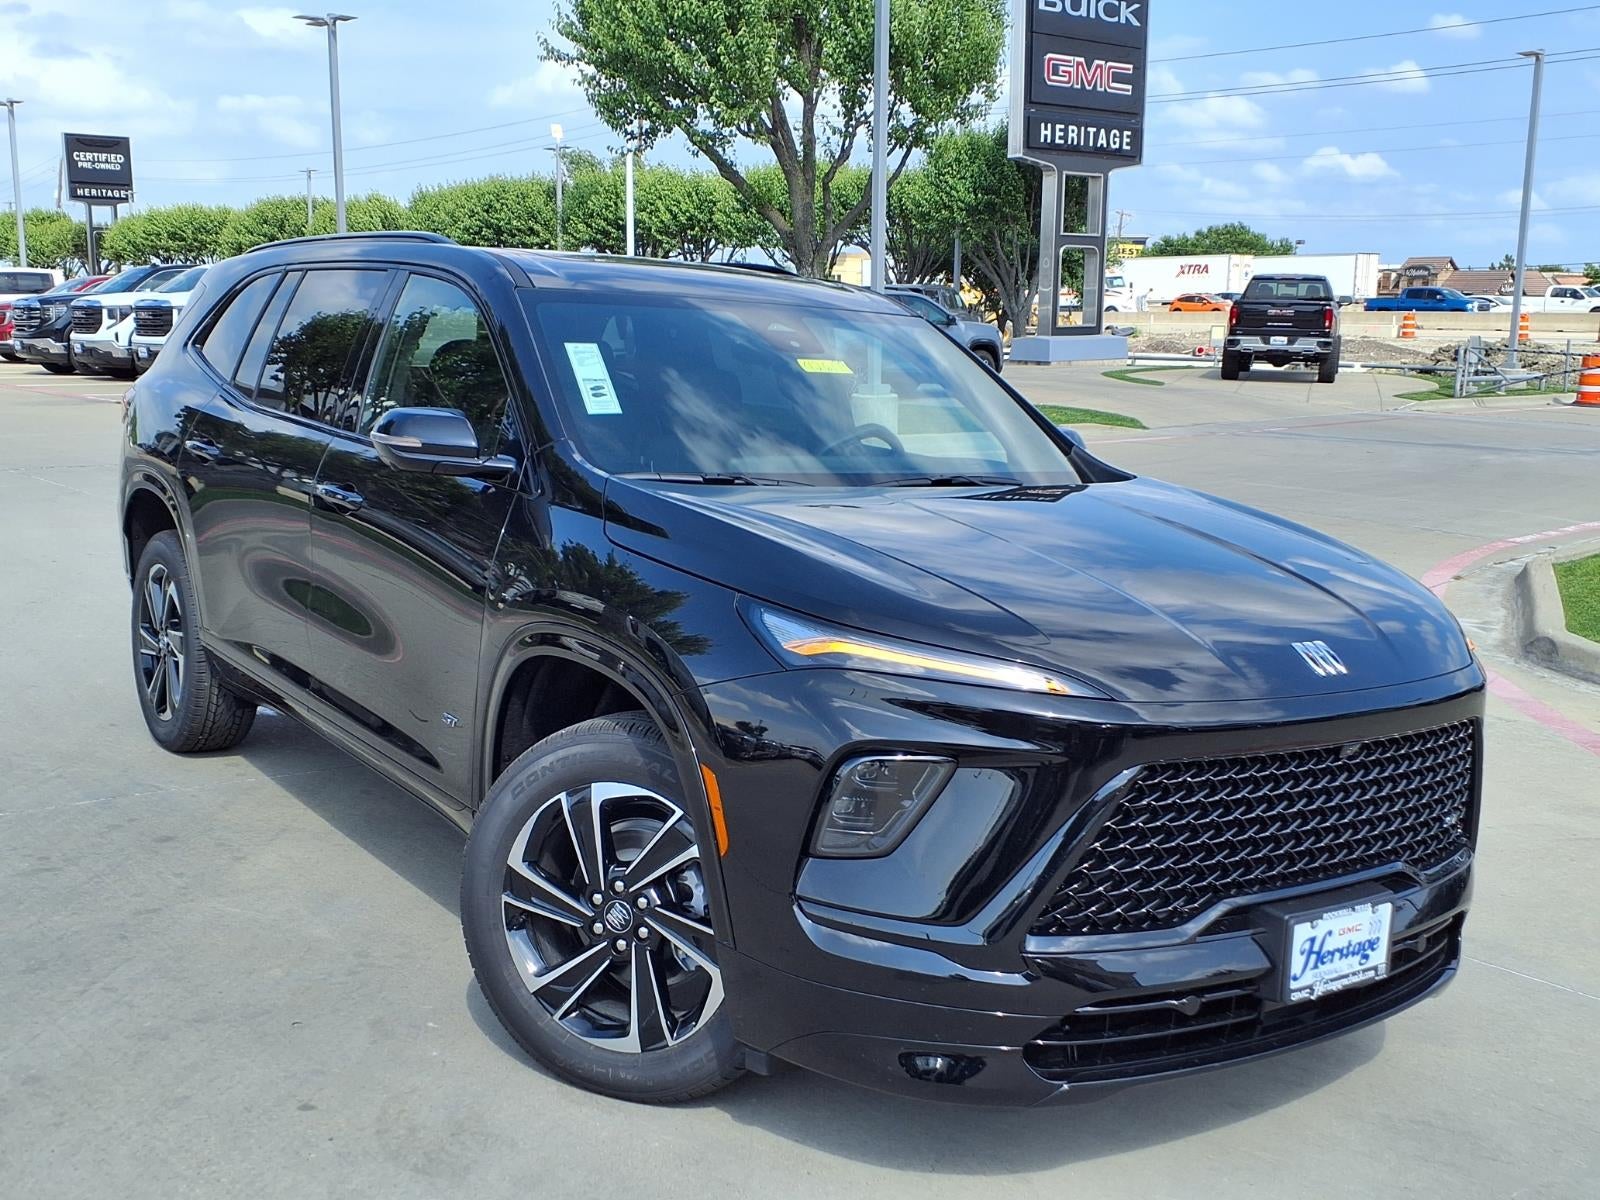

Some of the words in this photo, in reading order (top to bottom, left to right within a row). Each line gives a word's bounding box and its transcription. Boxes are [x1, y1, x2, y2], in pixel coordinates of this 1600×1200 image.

[1038, 0, 1141, 26] BUICK
[1044, 53, 1133, 95] GMC
[1040, 122, 1132, 150] HERITAGE
[72, 151, 125, 163] CERTIFIED
[77, 161, 121, 170] PRE-OWNED
[76, 188, 127, 198] HERITAGE
[1176, 264, 1209, 278] XTRA
[1338, 923, 1364, 936] GMC
[1291, 930, 1381, 982] Heritage
